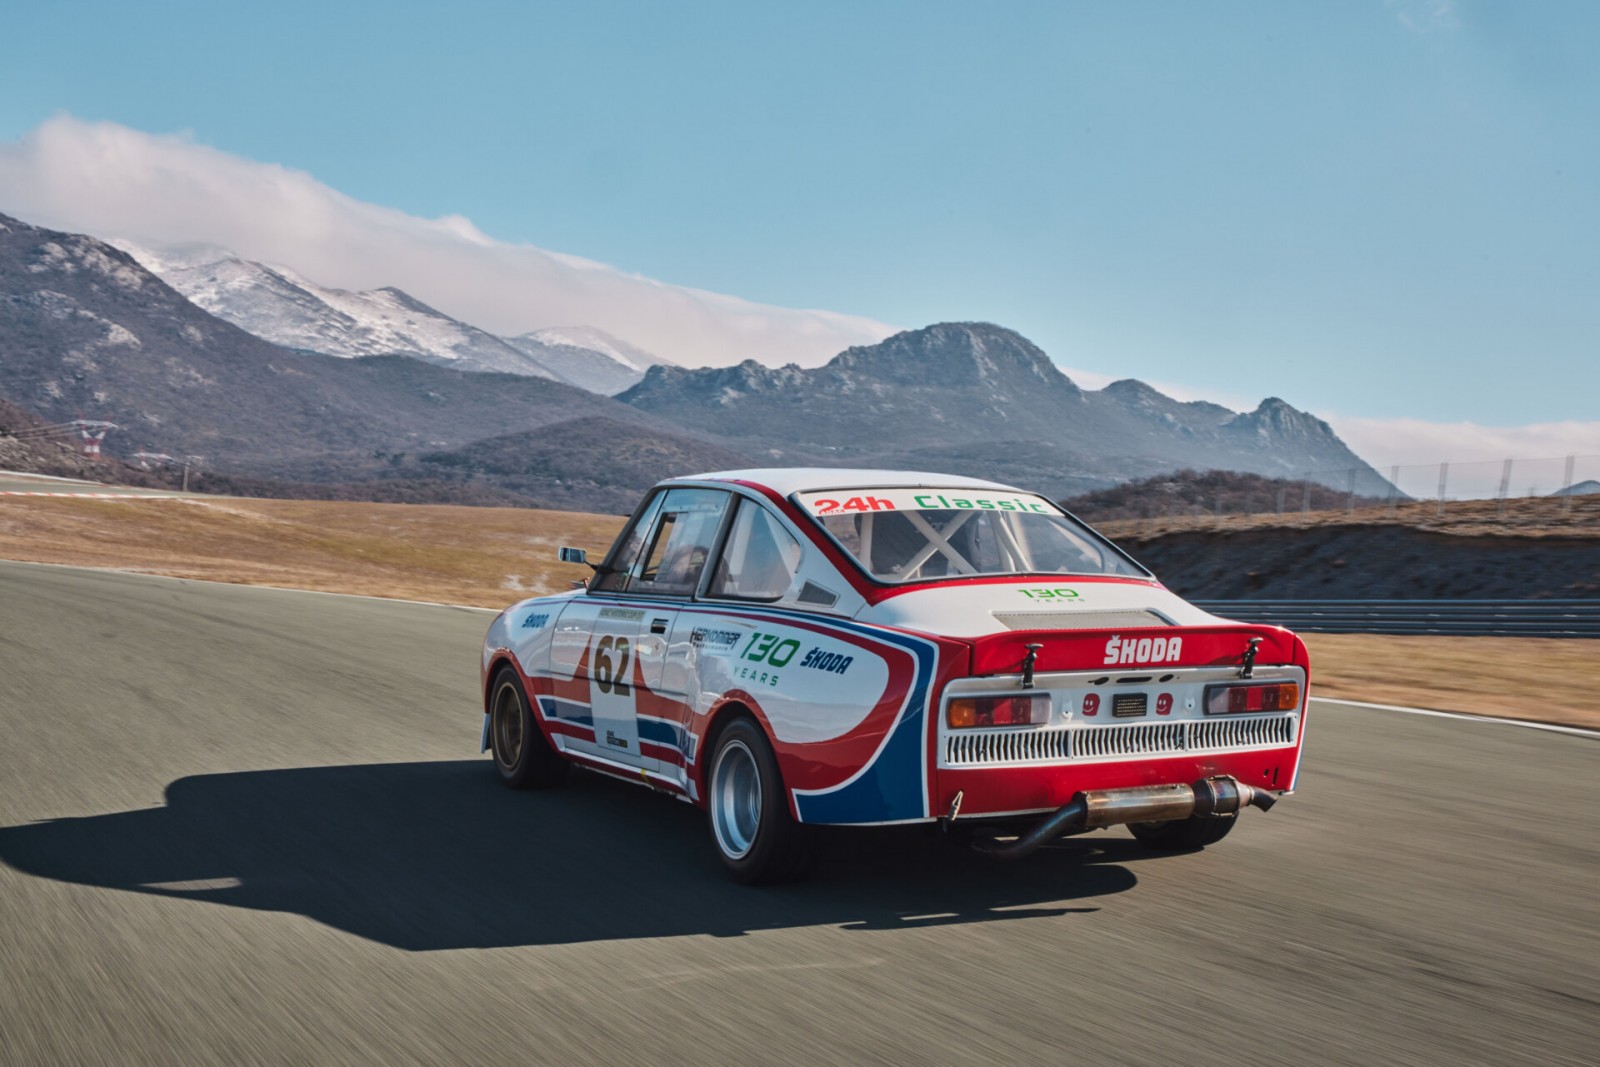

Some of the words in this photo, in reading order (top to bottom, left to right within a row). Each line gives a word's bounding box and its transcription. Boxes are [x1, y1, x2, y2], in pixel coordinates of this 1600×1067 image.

[814, 496, 896, 515] 24h
[914, 495, 1048, 514] Classic
[1016, 588, 1079, 598] 130
[740, 632, 801, 668] 130
[800, 646, 855, 675] ŠKODA
[1103, 635, 1183, 665] ŠKODA
[594, 635, 631, 697] 62
[734, 665, 779, 687] YEARS
